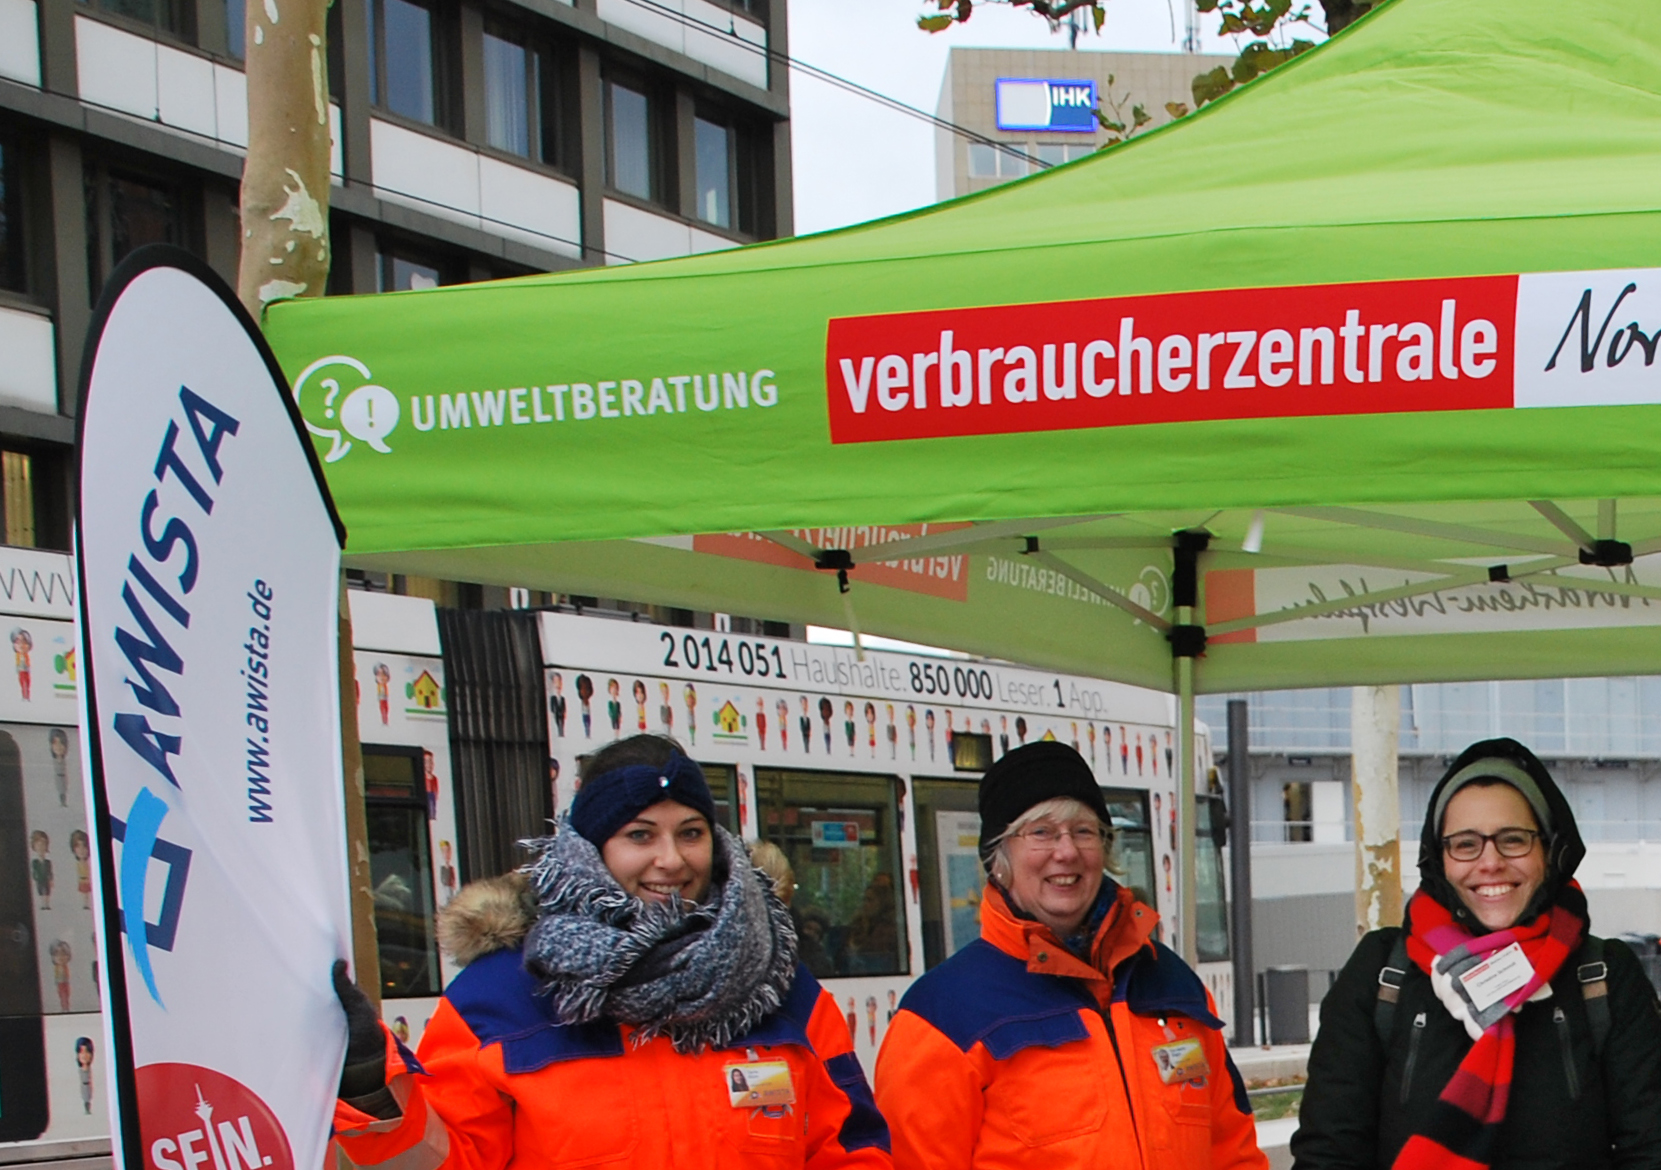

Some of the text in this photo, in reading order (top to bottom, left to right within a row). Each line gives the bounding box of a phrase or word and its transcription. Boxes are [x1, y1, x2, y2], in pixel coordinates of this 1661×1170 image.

[1052, 85, 1092, 108] IHK
[410, 368, 779, 433] UMWELTBERATUNG
[838, 298, 1499, 415] verbraucherzentrale
[113, 385, 241, 790] AWISTA
[248, 578, 274, 824] www.awista.de
